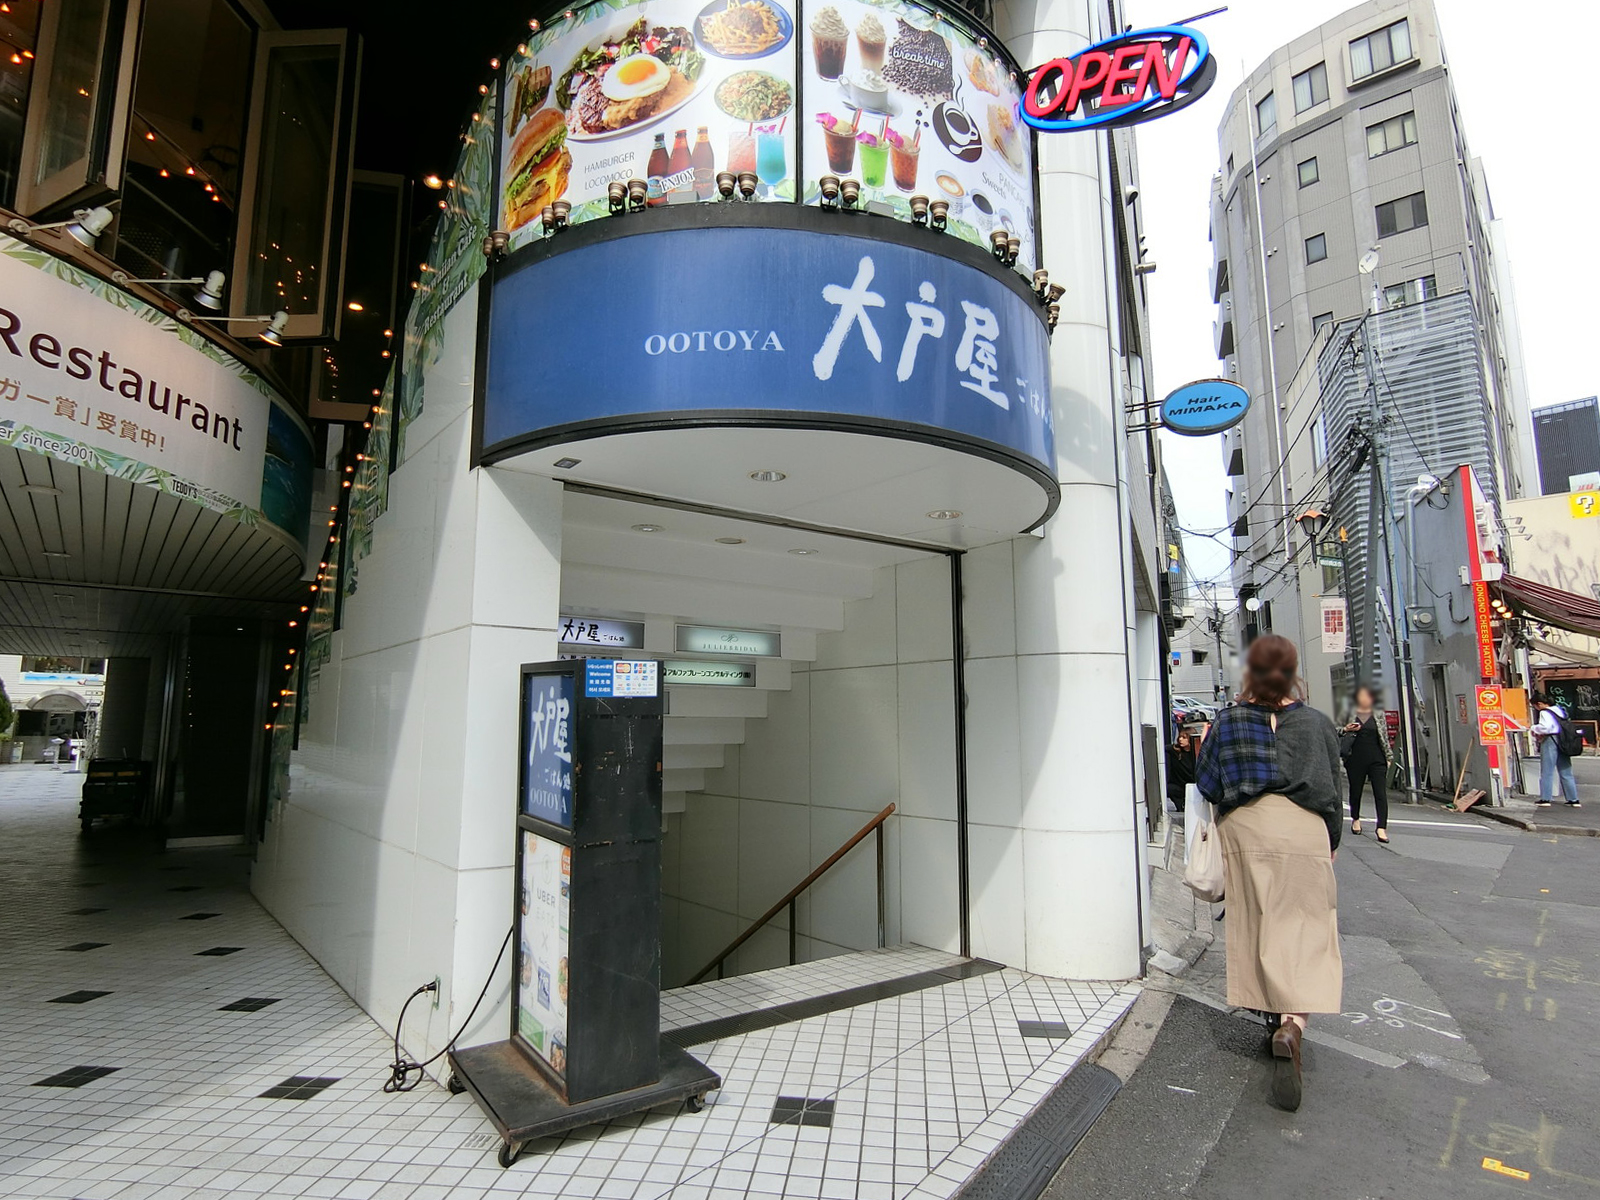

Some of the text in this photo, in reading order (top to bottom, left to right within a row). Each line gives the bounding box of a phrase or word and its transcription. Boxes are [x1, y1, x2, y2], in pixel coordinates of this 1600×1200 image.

[893, 47, 945, 70] break time
[1024, 36, 1192, 117] OPEN
[584, 151, 635, 174] HAMBURGER
[584, 168, 634, 190] LOCOMOCO
[661, 168, 695, 191] ENJOY
[981, 171, 1007, 200] Sweets
[644, 330, 785, 356] OOTOYA
[812, 255, 1009, 411] 大戸屋
[0, 306, 243, 452] Restaurant
[1167, 400, 1243, 417] MIMAKA
[1187, 394, 1222, 406] Hair
[22, 432, 60, 452] since
[63, 442, 94, 462] 2001
[172, 479, 198, 499] TEDDY'S
[1475, 582, 1487, 613] JONGNO
[561, 618, 601, 643] 大戸屋
[1479, 614, 1490, 644] CHEESE
[529, 686, 572, 767] 大戸屋
[529, 786, 568, 814] OOTOYA
[536, 887, 556, 909] UBER
